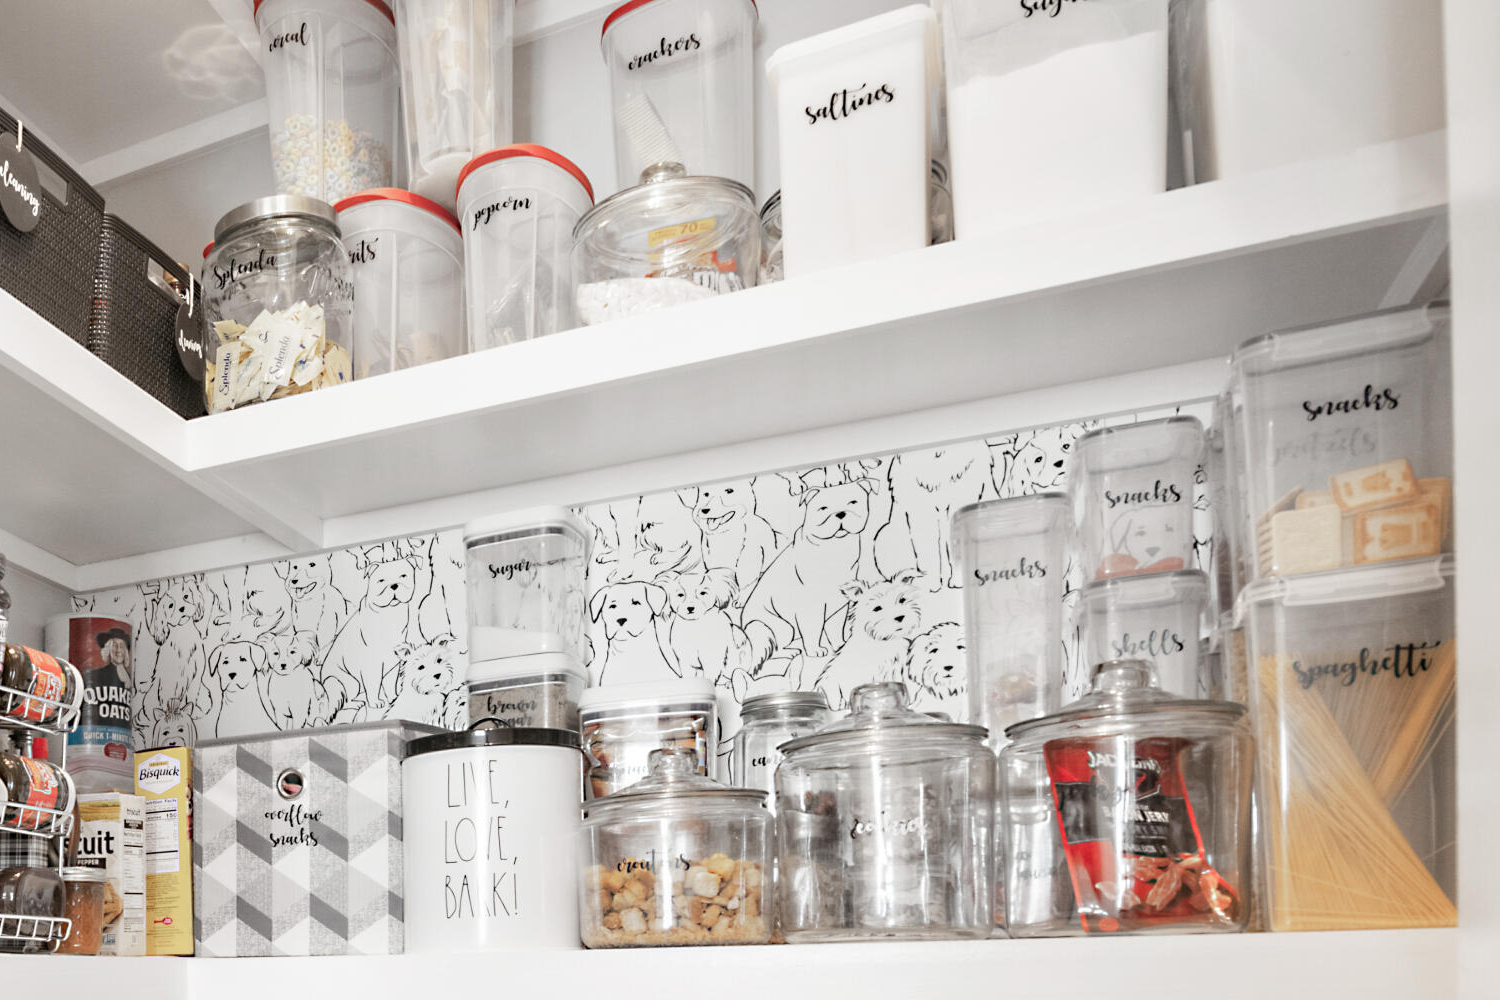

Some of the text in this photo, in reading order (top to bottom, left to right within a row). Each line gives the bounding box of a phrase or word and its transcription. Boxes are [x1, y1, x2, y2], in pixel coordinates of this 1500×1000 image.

[627, 31, 702, 71] crackers
[805, 80, 896, 126] saltines
[0, 160, 41, 217] cleaning
[473, 196, 532, 231] popcorn
[214, 249, 278, 290] Splenda
[218, 352, 232, 396] Splenda
[269, 334, 291, 381] Splenda
[1303, 384, 1401, 421] snacks
[1105, 480, 1182, 508] snacks
[487, 559, 533, 580] sugar
[974, 557, 1048, 586] snacks
[1112, 628, 1185, 658] shells
[1292, 640, 1442, 689] spaghetti
[100, 703, 131, 721] OATS
[487, 696, 538, 715] brown
[139, 766, 180, 780] Bisquick
[269, 827, 319, 848] snacks
[445, 872, 518, 919] BAK!
